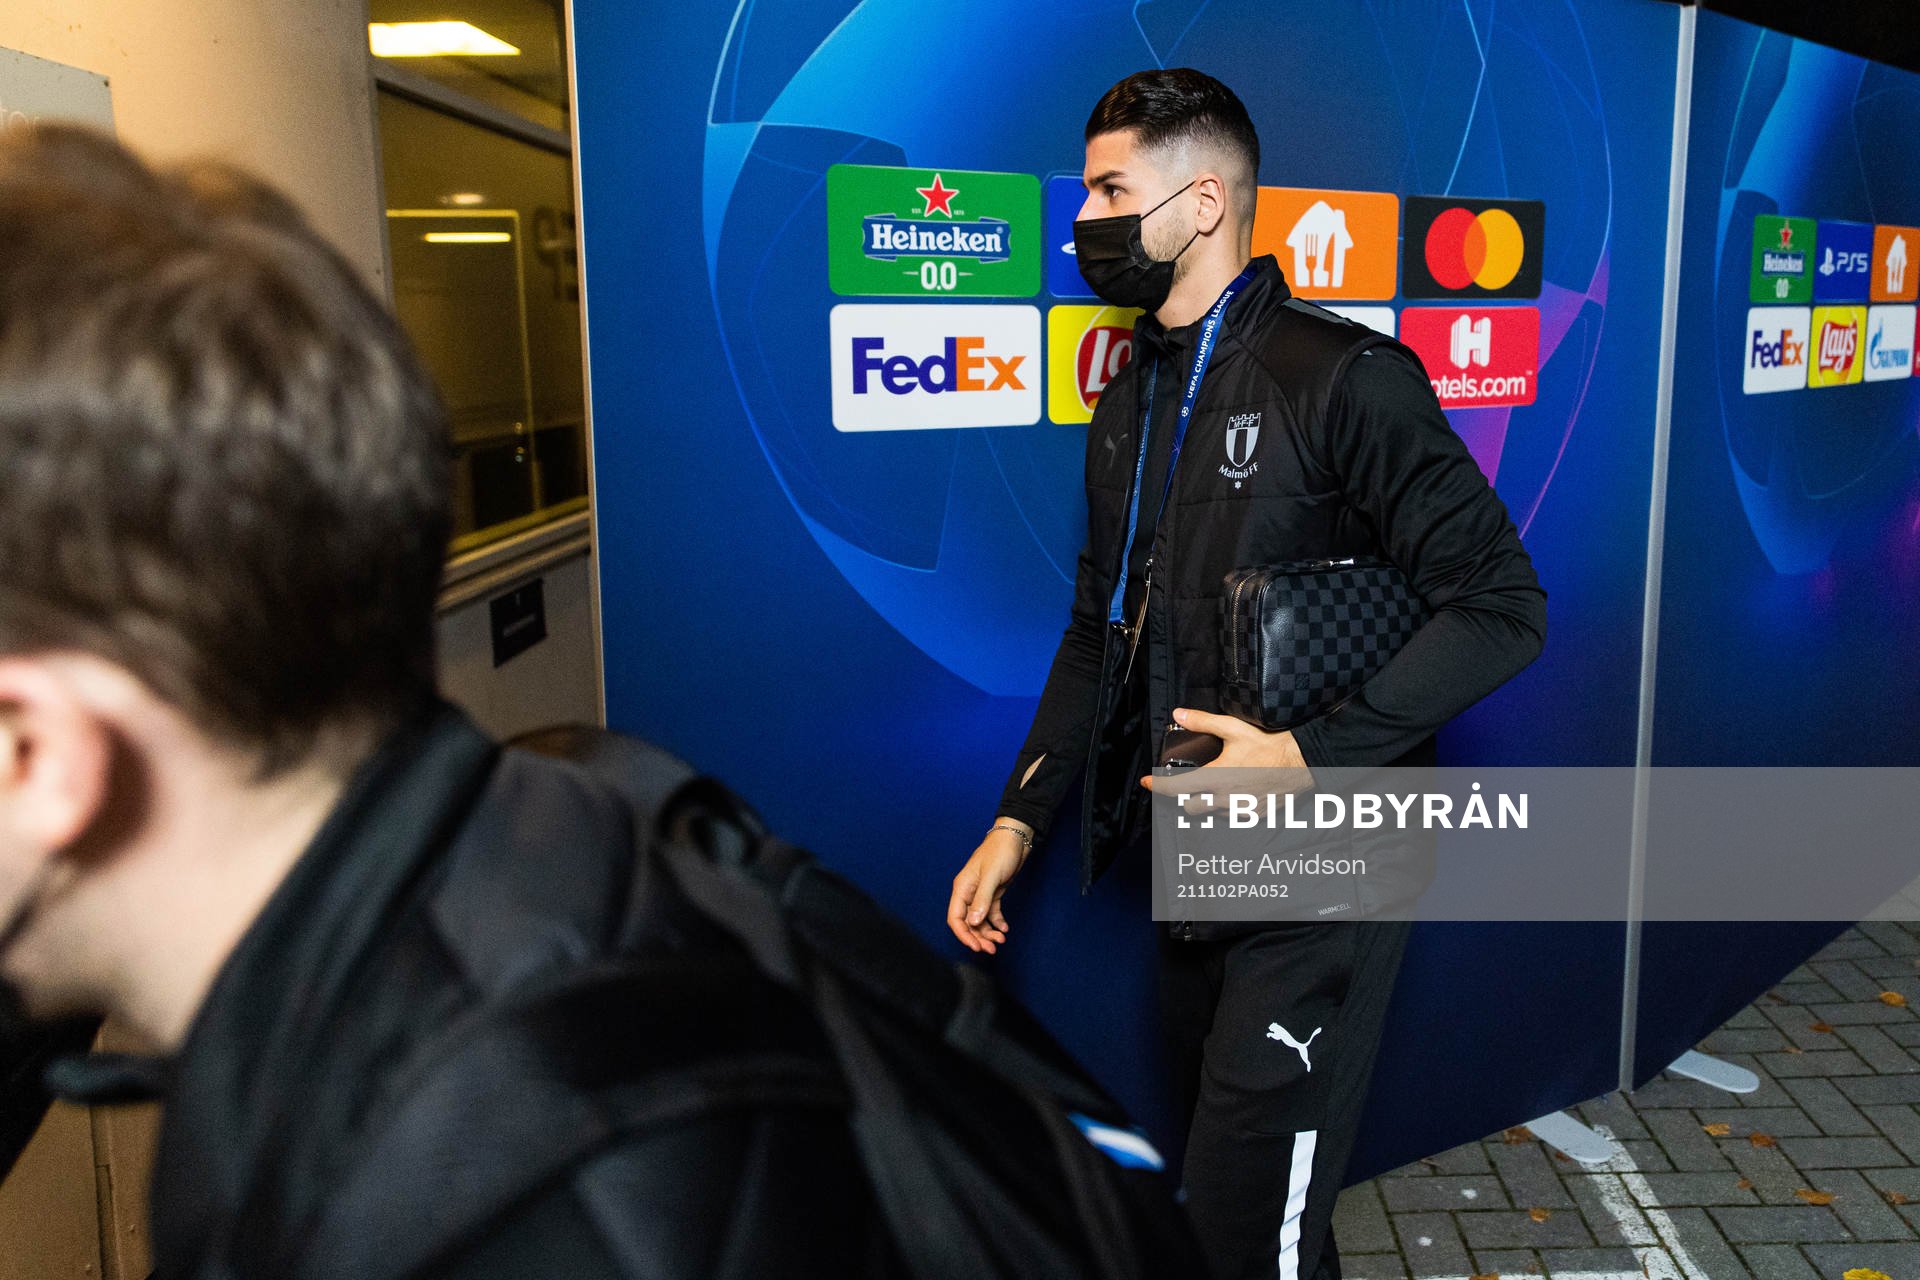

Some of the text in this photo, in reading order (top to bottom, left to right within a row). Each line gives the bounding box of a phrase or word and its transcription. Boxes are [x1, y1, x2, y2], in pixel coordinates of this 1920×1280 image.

[871, 223, 1003, 252] Heineken
[920, 261, 957, 290] 0.0
[1836, 252, 1868, 273] PS5
[1187, 290, 1235, 399] UEFA CHAMPIONS LEAGUE
[1751, 329, 1804, 369] FedEx
[851, 336, 1027, 395] FedEx
[1430, 373, 1527, 400] otels.com
[1218, 461, 1259, 479] Malmö FF
[1317, 902, 1352, 916] WARMCELL
